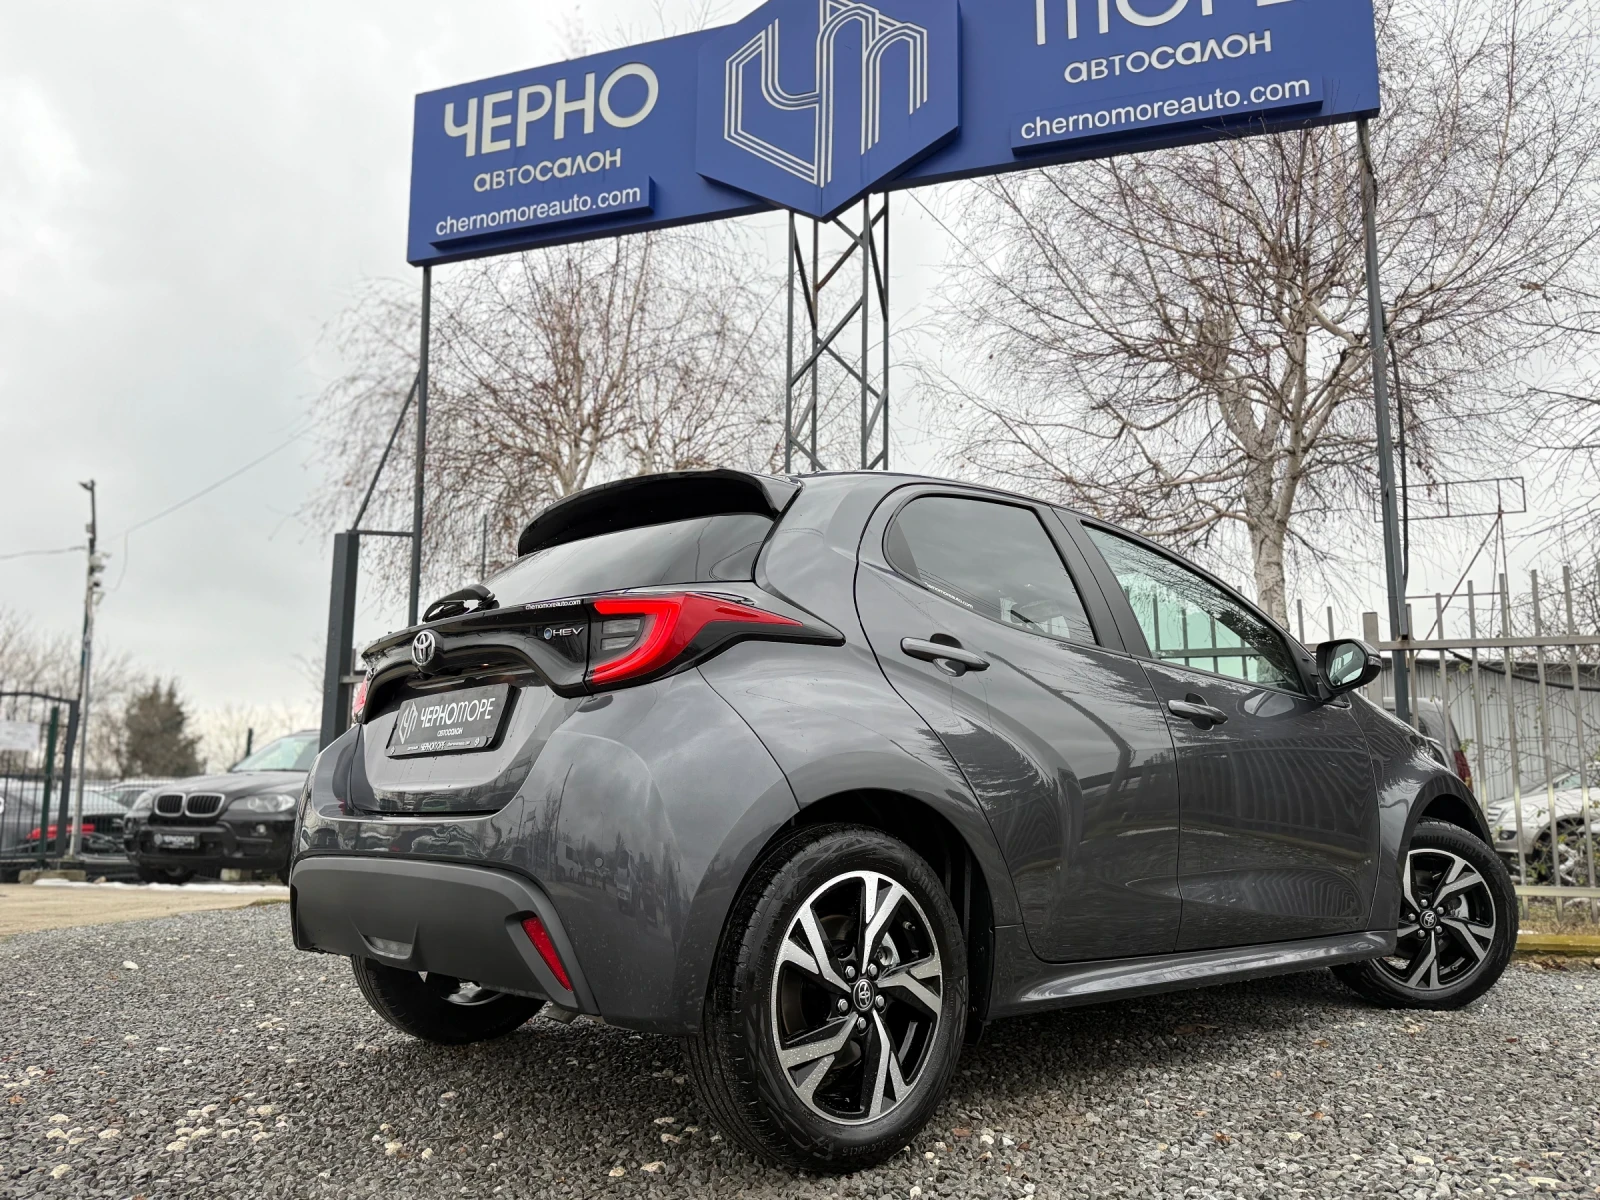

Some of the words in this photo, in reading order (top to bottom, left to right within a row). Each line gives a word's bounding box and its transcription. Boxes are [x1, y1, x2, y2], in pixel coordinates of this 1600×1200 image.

[444, 62, 659, 157] ЧЕРНО
[1021, 79, 1310, 139] chernomoreauto.com
[436, 187, 641, 235] chernomoreauto.com
[553, 626, 584, 637] HEV
[420, 697, 496, 729] ЧЕРНОМОРЕ
